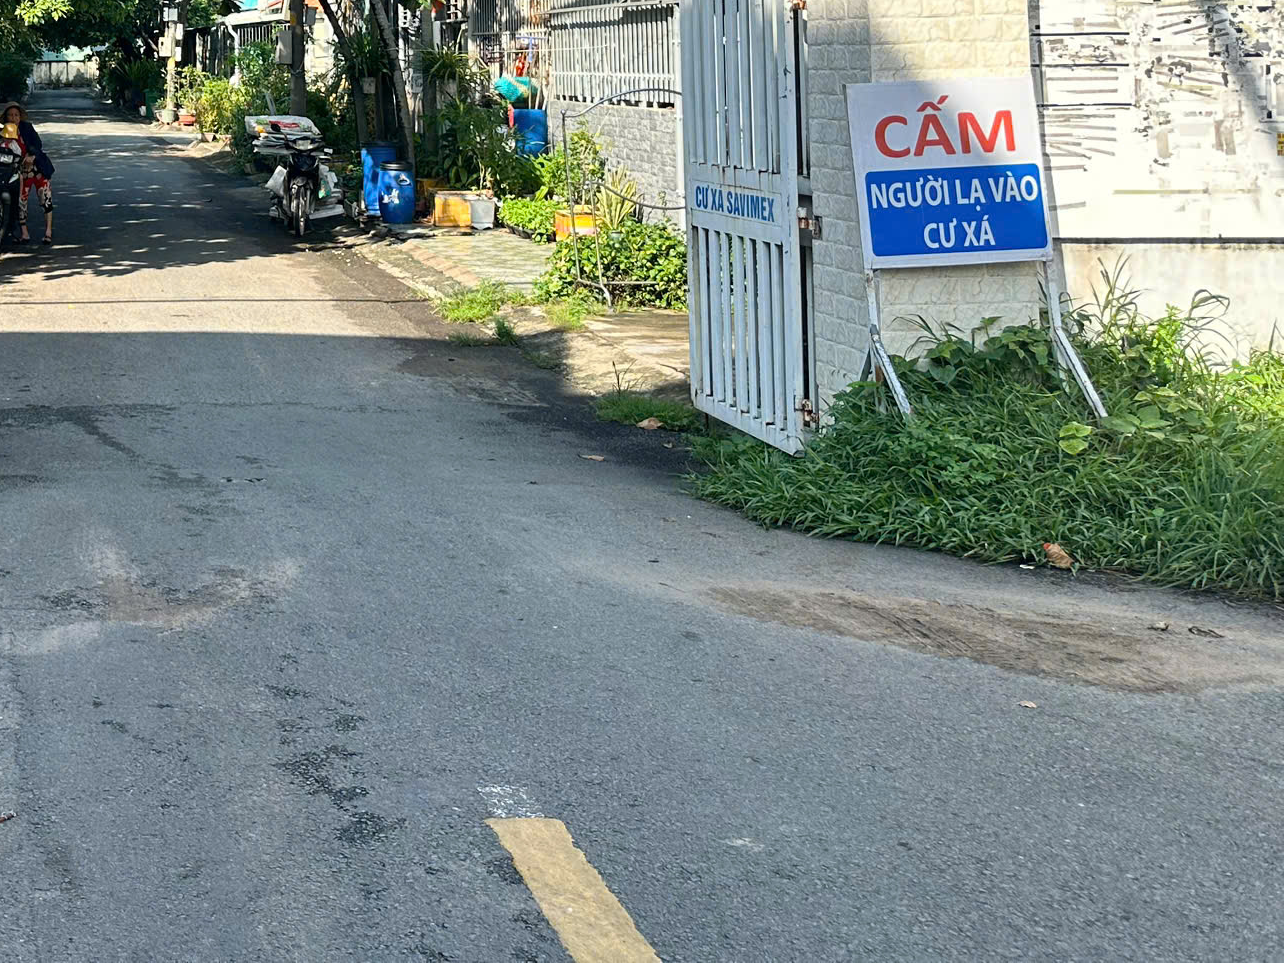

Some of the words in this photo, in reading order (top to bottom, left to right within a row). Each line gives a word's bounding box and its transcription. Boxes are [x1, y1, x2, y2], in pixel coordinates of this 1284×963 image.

[874, 95, 1016, 159] CẤM
[695, 184, 710, 209] CƯ
[726, 190, 775, 222] SAVIMEX
[870, 174, 950, 209] NGƯỜI
[955, 178, 986, 212] LẠ
[988, 170, 1039, 203] VÀO
[923, 218, 957, 249] CƯ
[961, 215, 996, 247] XÁ
